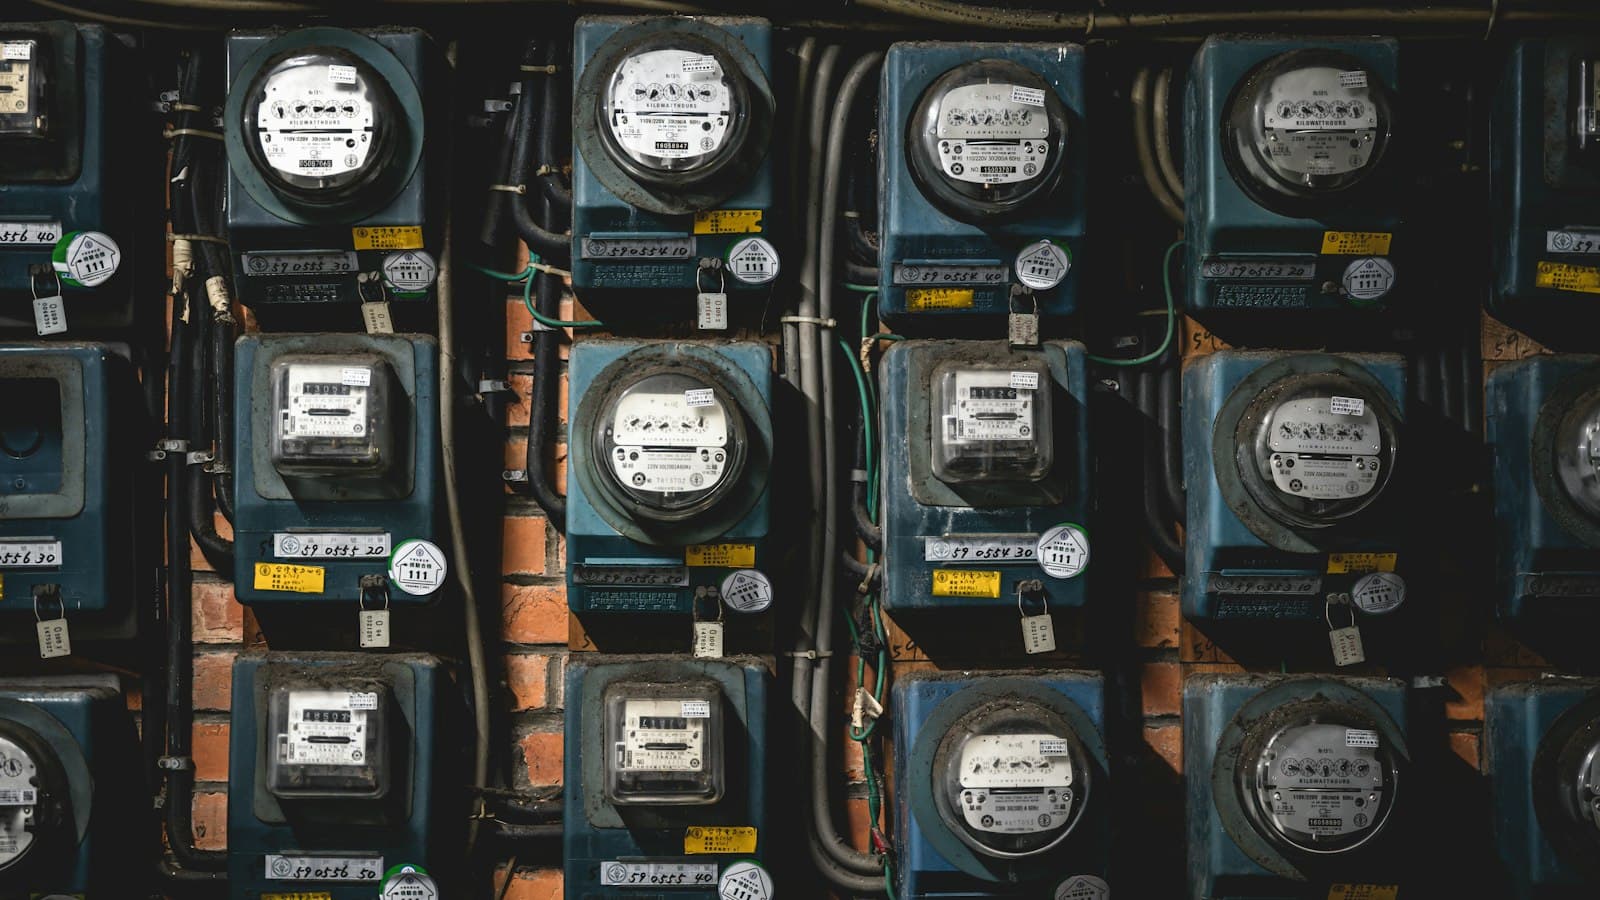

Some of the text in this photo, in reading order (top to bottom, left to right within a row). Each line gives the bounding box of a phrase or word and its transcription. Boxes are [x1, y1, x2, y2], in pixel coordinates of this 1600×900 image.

[38, 231, 55, 242] 40
[1573, 241, 1592, 255] 59
[86, 261, 105, 273] 111
[271, 261, 350, 273] 59 0555 30
[745, 263, 764, 271] 111
[1030, 266, 1049, 276] 111
[1229, 266, 1245, 277] 59
[1287, 266, 1305, 276] 20
[400, 272, 420, 280] 111
[922, 273, 937, 282] 59
[1359, 280, 1378, 288] 111
[302, 544, 384, 557] 59 0555 20
[952, 547, 1033, 559] 59 0554 30
[35, 553, 55, 563] 30
[1053, 553, 1071, 564] 111
[409, 570, 427, 580] 111
[741, 591, 759, 602] 111
[1370, 594, 1389, 603] 111
[294, 865, 375, 879] 59 0556 50
[629, 872, 712, 883] 59 0555 40
